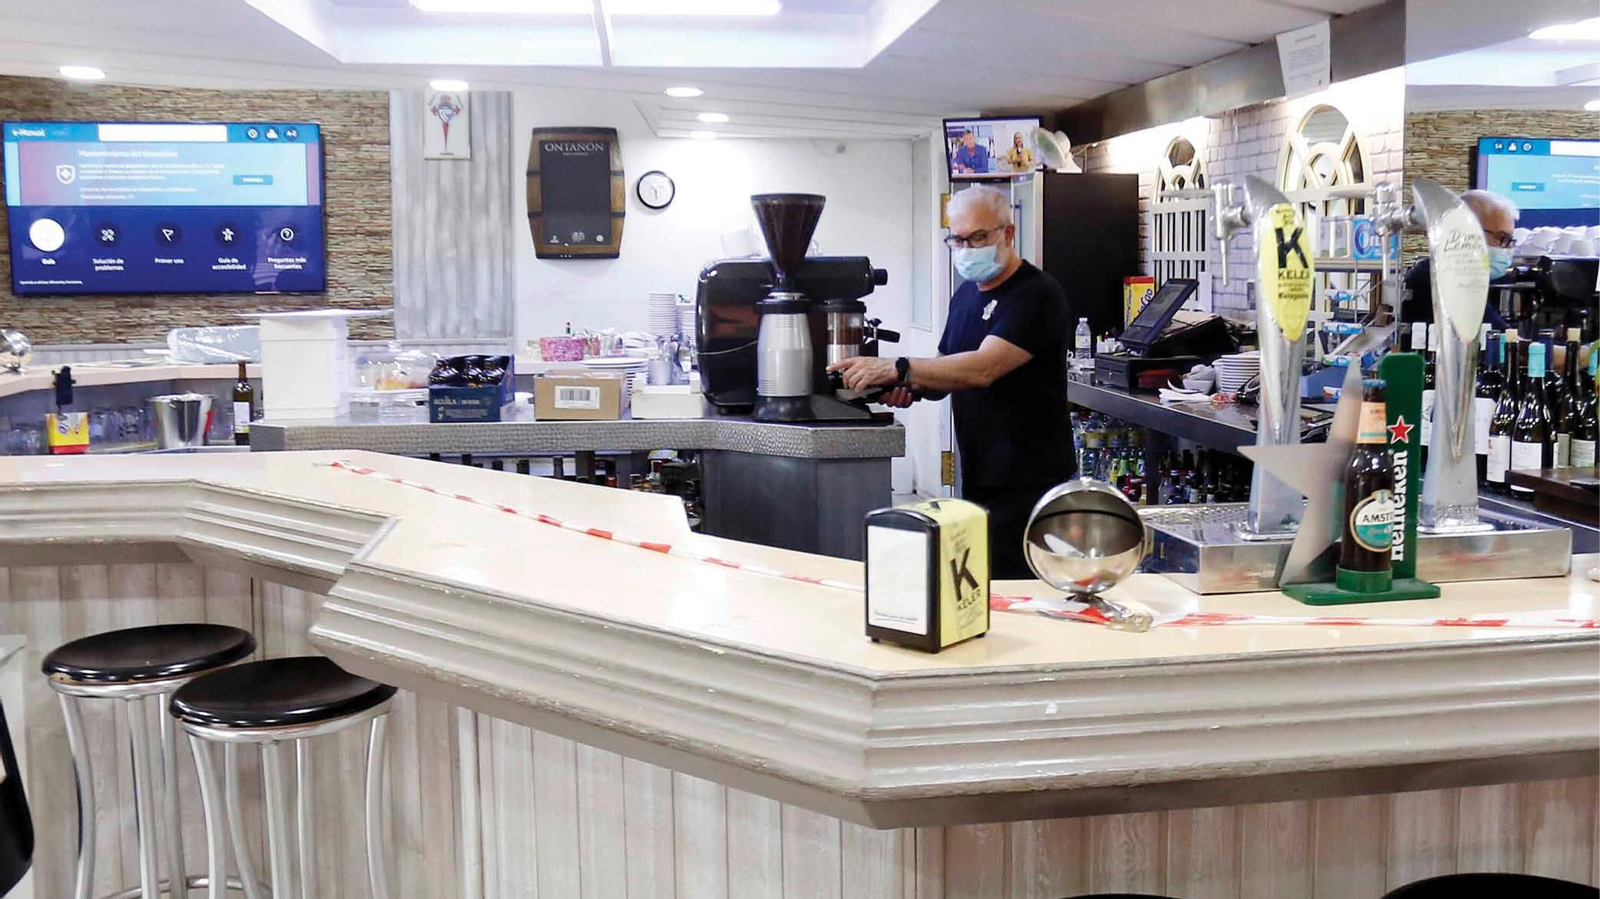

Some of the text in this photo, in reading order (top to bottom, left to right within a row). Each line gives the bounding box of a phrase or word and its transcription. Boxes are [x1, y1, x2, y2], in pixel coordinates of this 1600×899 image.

[1275, 228, 1309, 269] K
[950, 547, 979, 602] K
[957, 588, 982, 611] KELER
